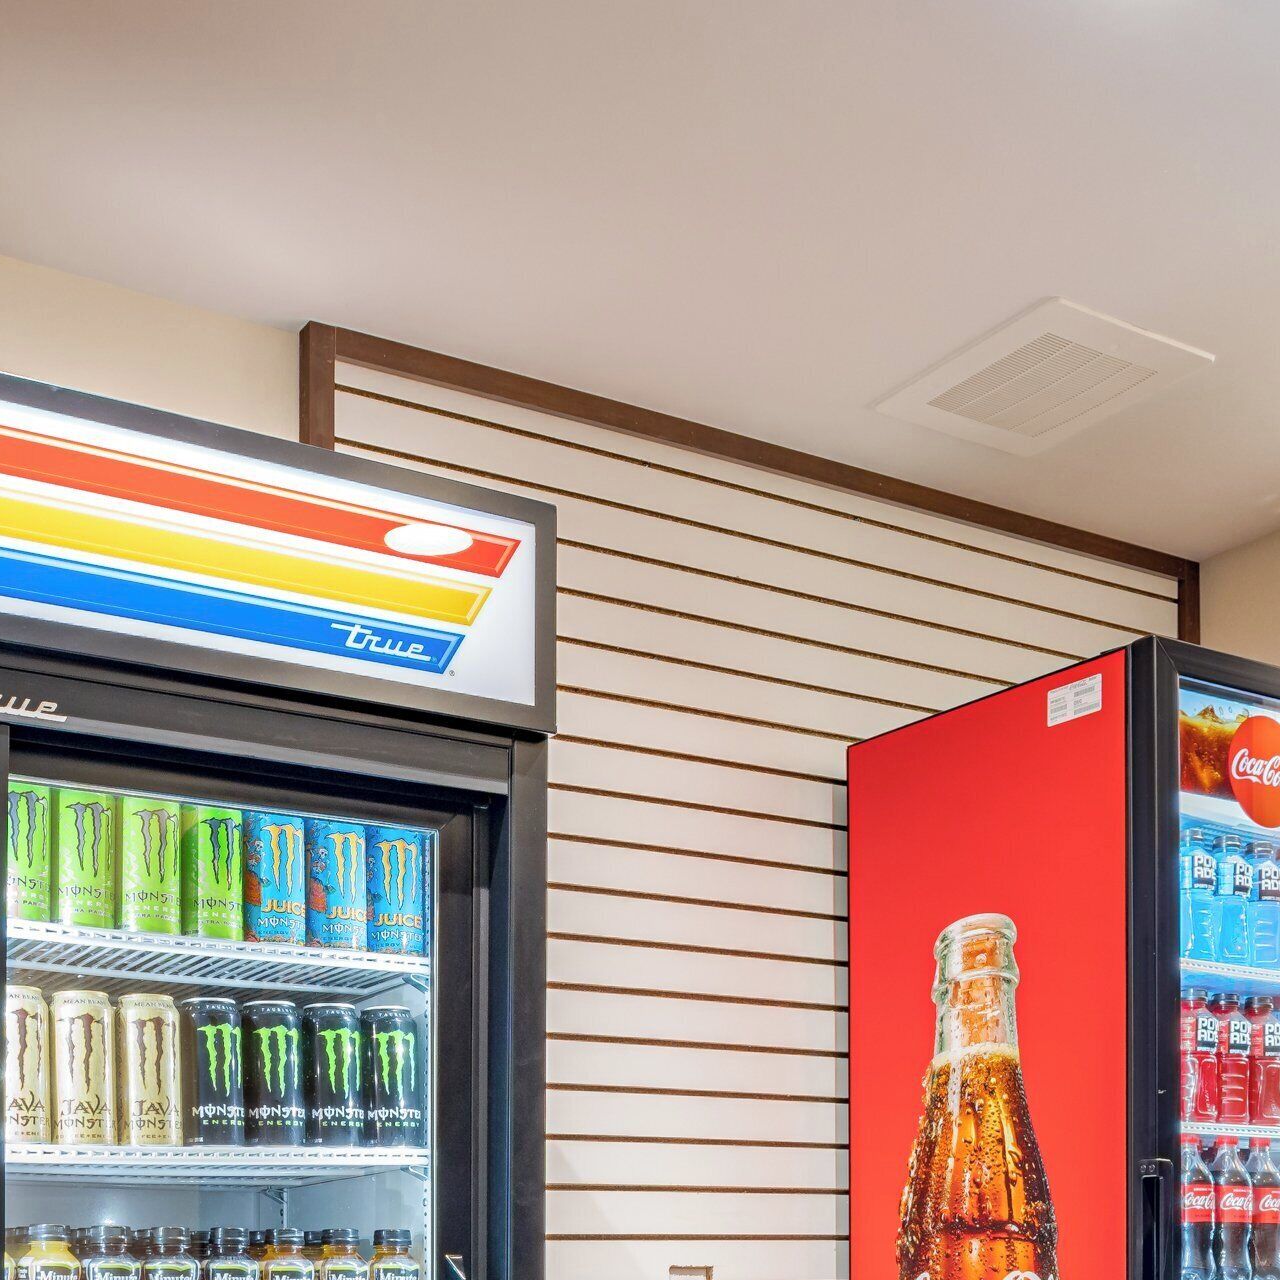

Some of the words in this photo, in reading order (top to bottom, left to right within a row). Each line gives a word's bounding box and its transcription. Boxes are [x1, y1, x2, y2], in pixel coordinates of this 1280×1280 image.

[331, 623, 431, 661] true
[374, 913, 423, 929] JUICE
[61, 1094, 111, 1116] JAVA
[133, 1096, 179, 1116] JAVA
